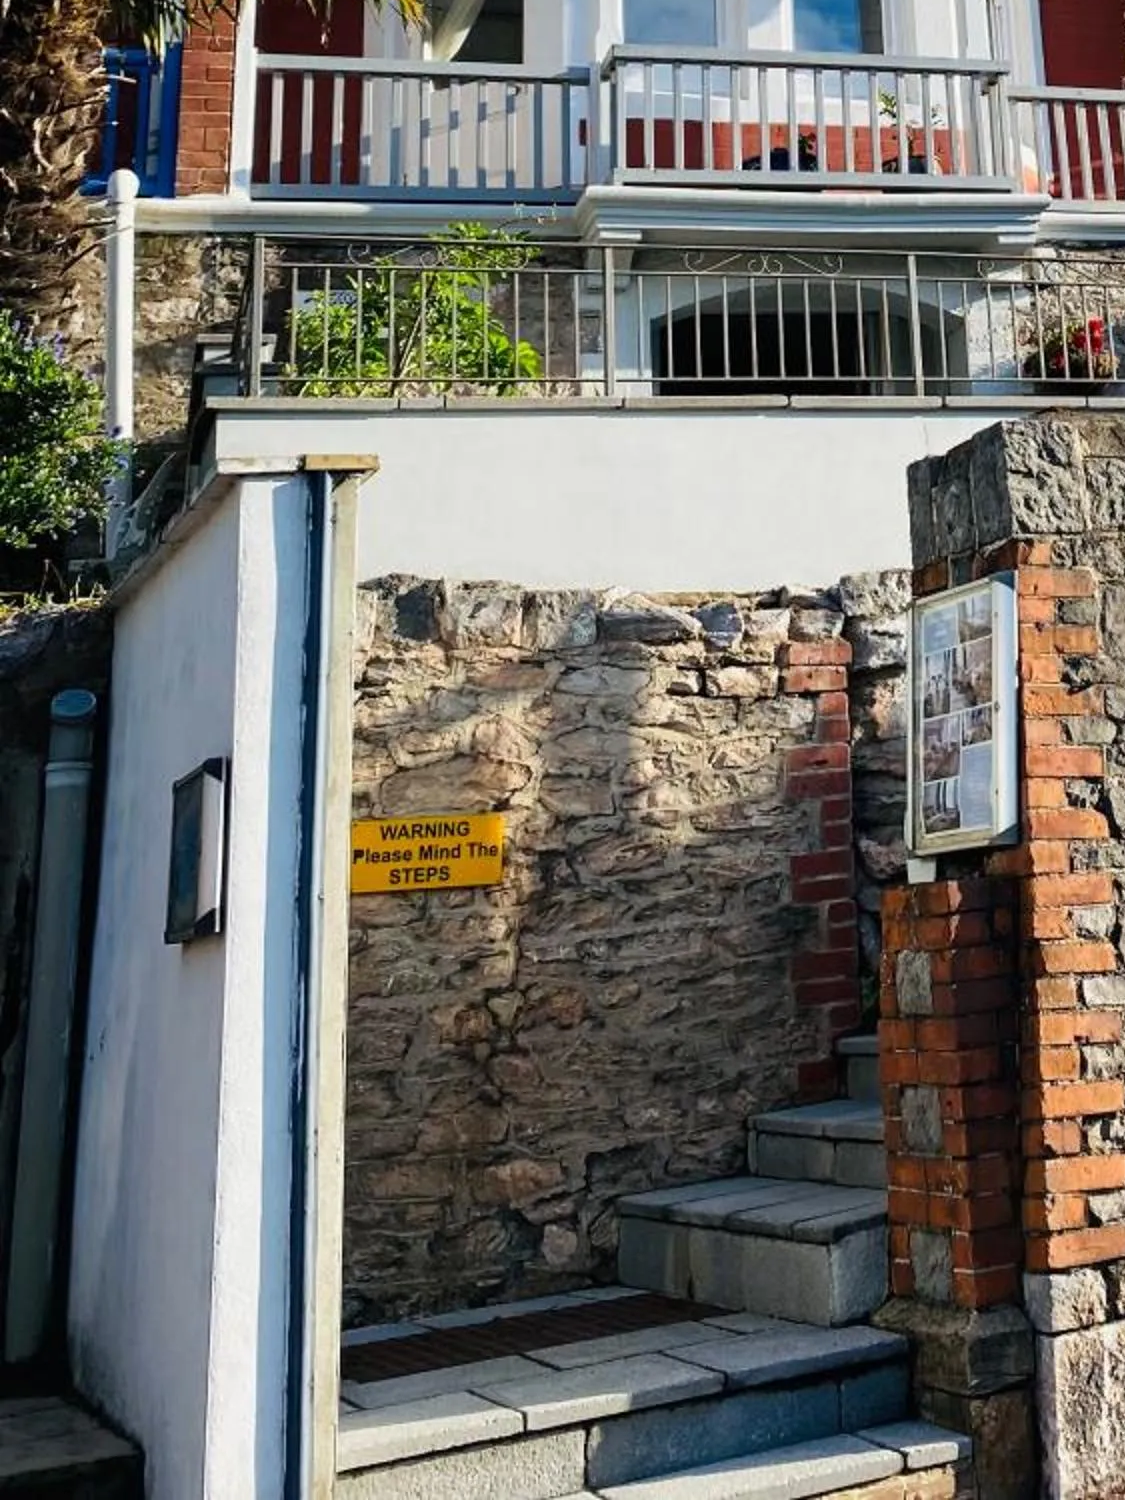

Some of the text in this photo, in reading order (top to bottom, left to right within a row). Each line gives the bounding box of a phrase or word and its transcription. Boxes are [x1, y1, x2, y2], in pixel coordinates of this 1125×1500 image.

[380, 821, 471, 841] WARNING
[352, 842, 498, 865] Please Mind The
[389, 866, 450, 885] STEPS
